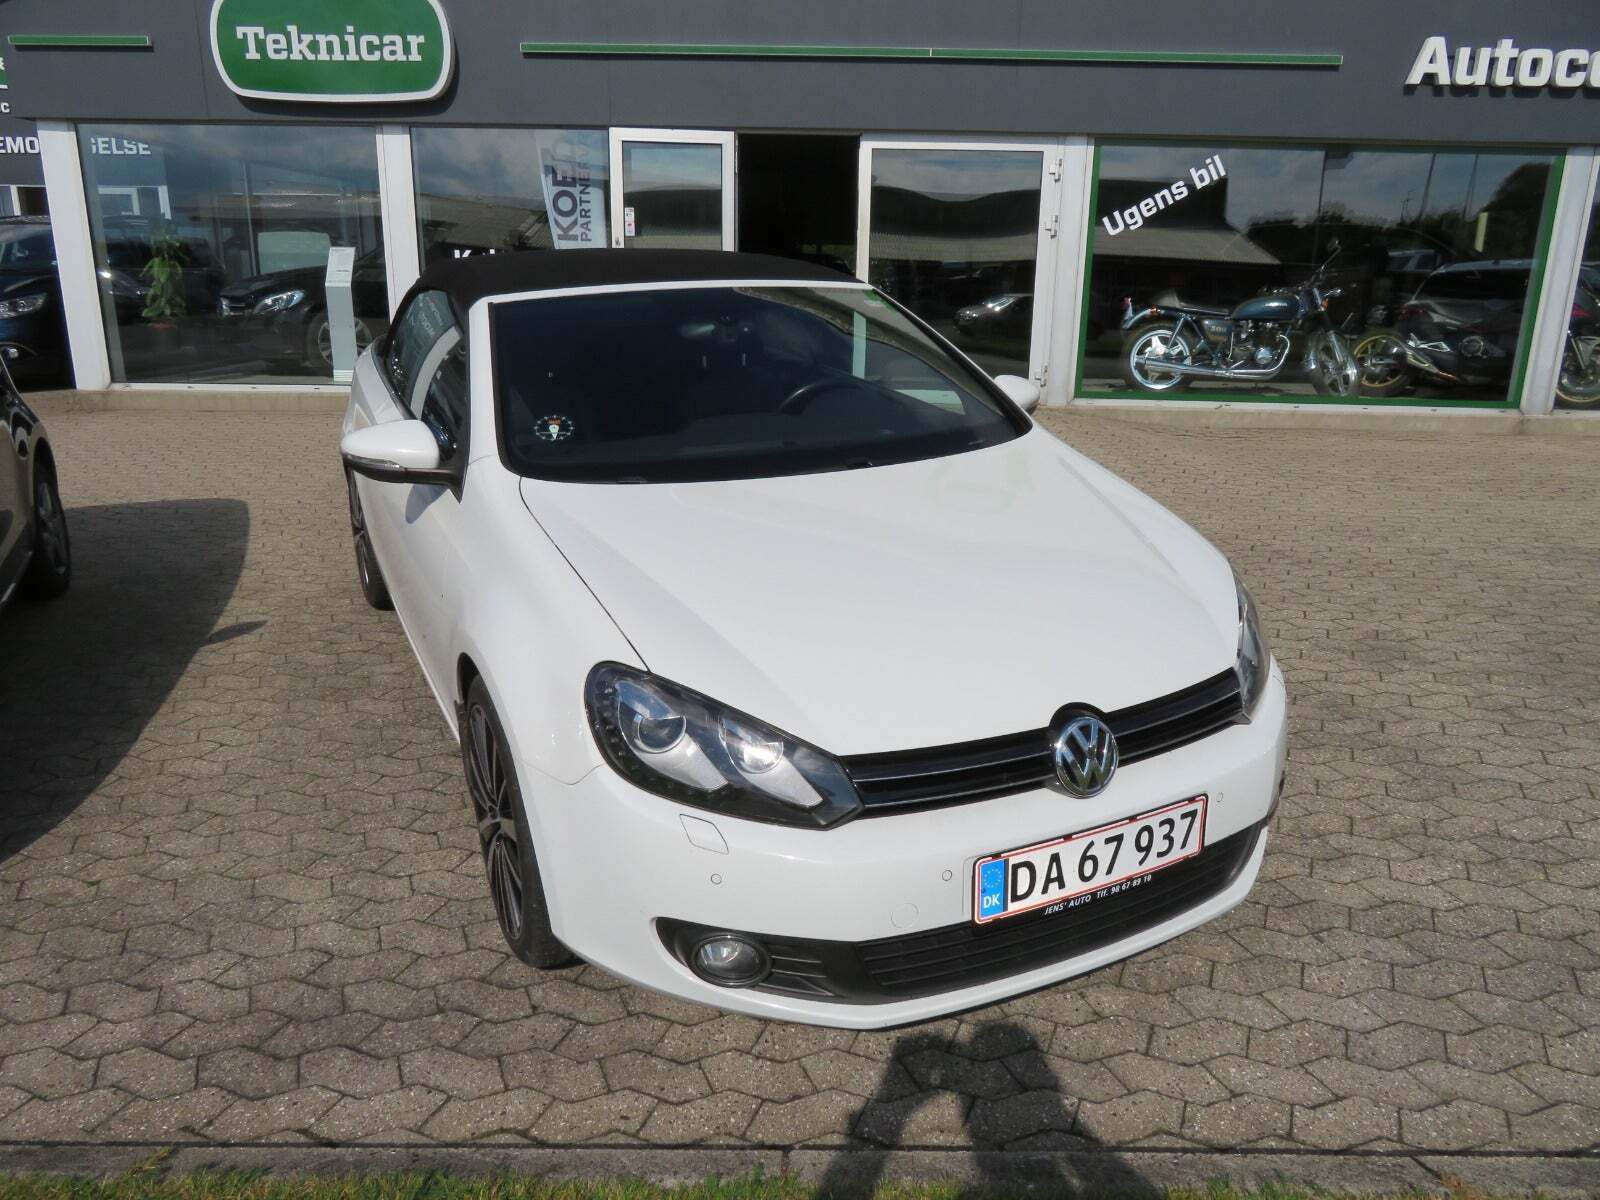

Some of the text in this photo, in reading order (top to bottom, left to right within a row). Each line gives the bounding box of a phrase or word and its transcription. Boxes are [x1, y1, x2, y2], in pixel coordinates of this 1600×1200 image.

[236, 25, 425, 62] Teknicar
[1404, 36, 1600, 88] Autoc
[1101, 154, 1227, 236] Ugens bil
[1010, 808, 1199, 903] DA 67 937
[983, 892, 1000, 909] DK
[1068, 894, 1092, 908] AUTO
